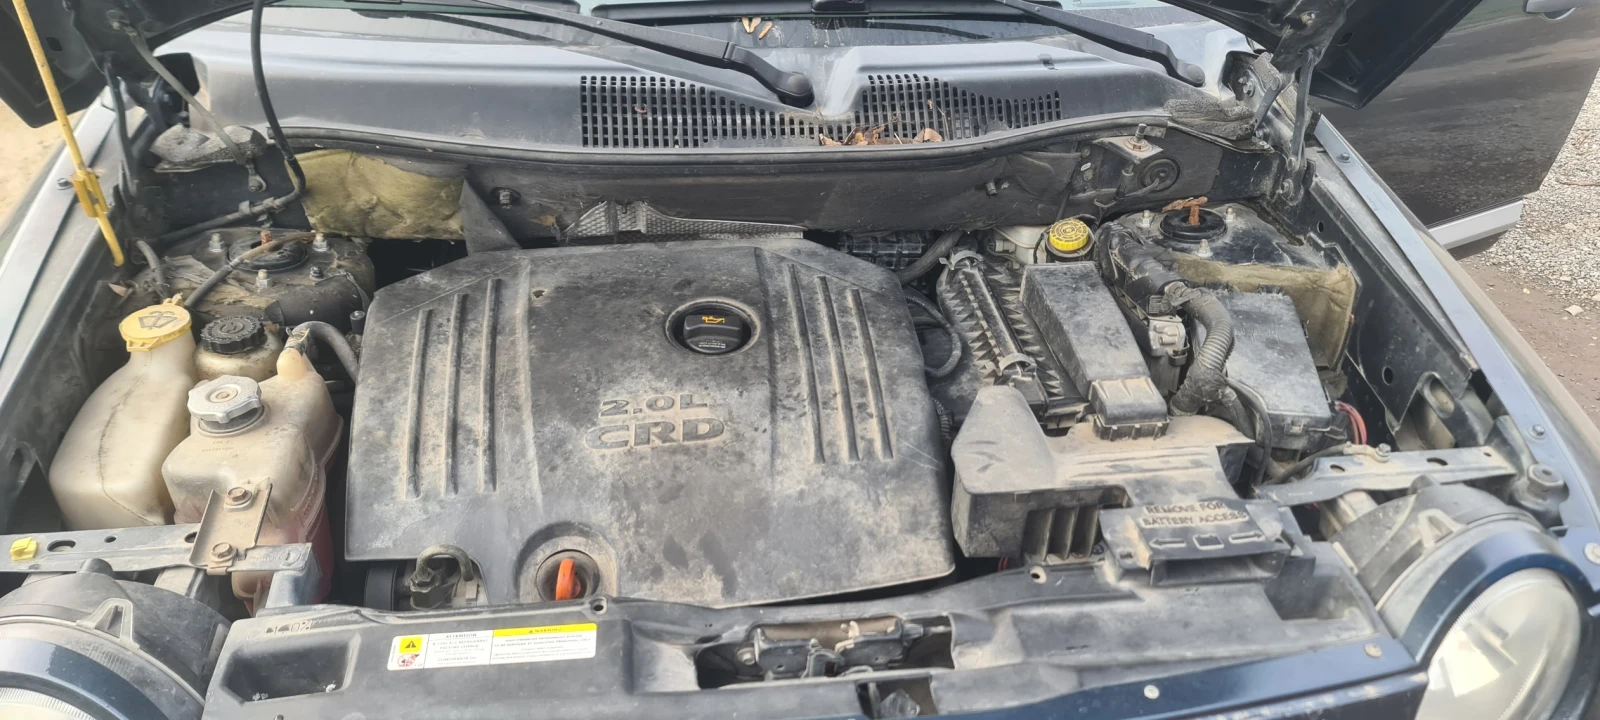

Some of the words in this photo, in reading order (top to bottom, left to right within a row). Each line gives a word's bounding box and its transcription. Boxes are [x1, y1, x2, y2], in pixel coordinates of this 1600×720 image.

[599, 393, 708, 418] 2.0L
[584, 417, 725, 450] CRD
[1144, 503, 1198, 515] REMOVE
[1199, 500, 1226, 512] FOR
[1141, 515, 1194, 526] BATTERY
[1199, 510, 1247, 524] ACCESS
